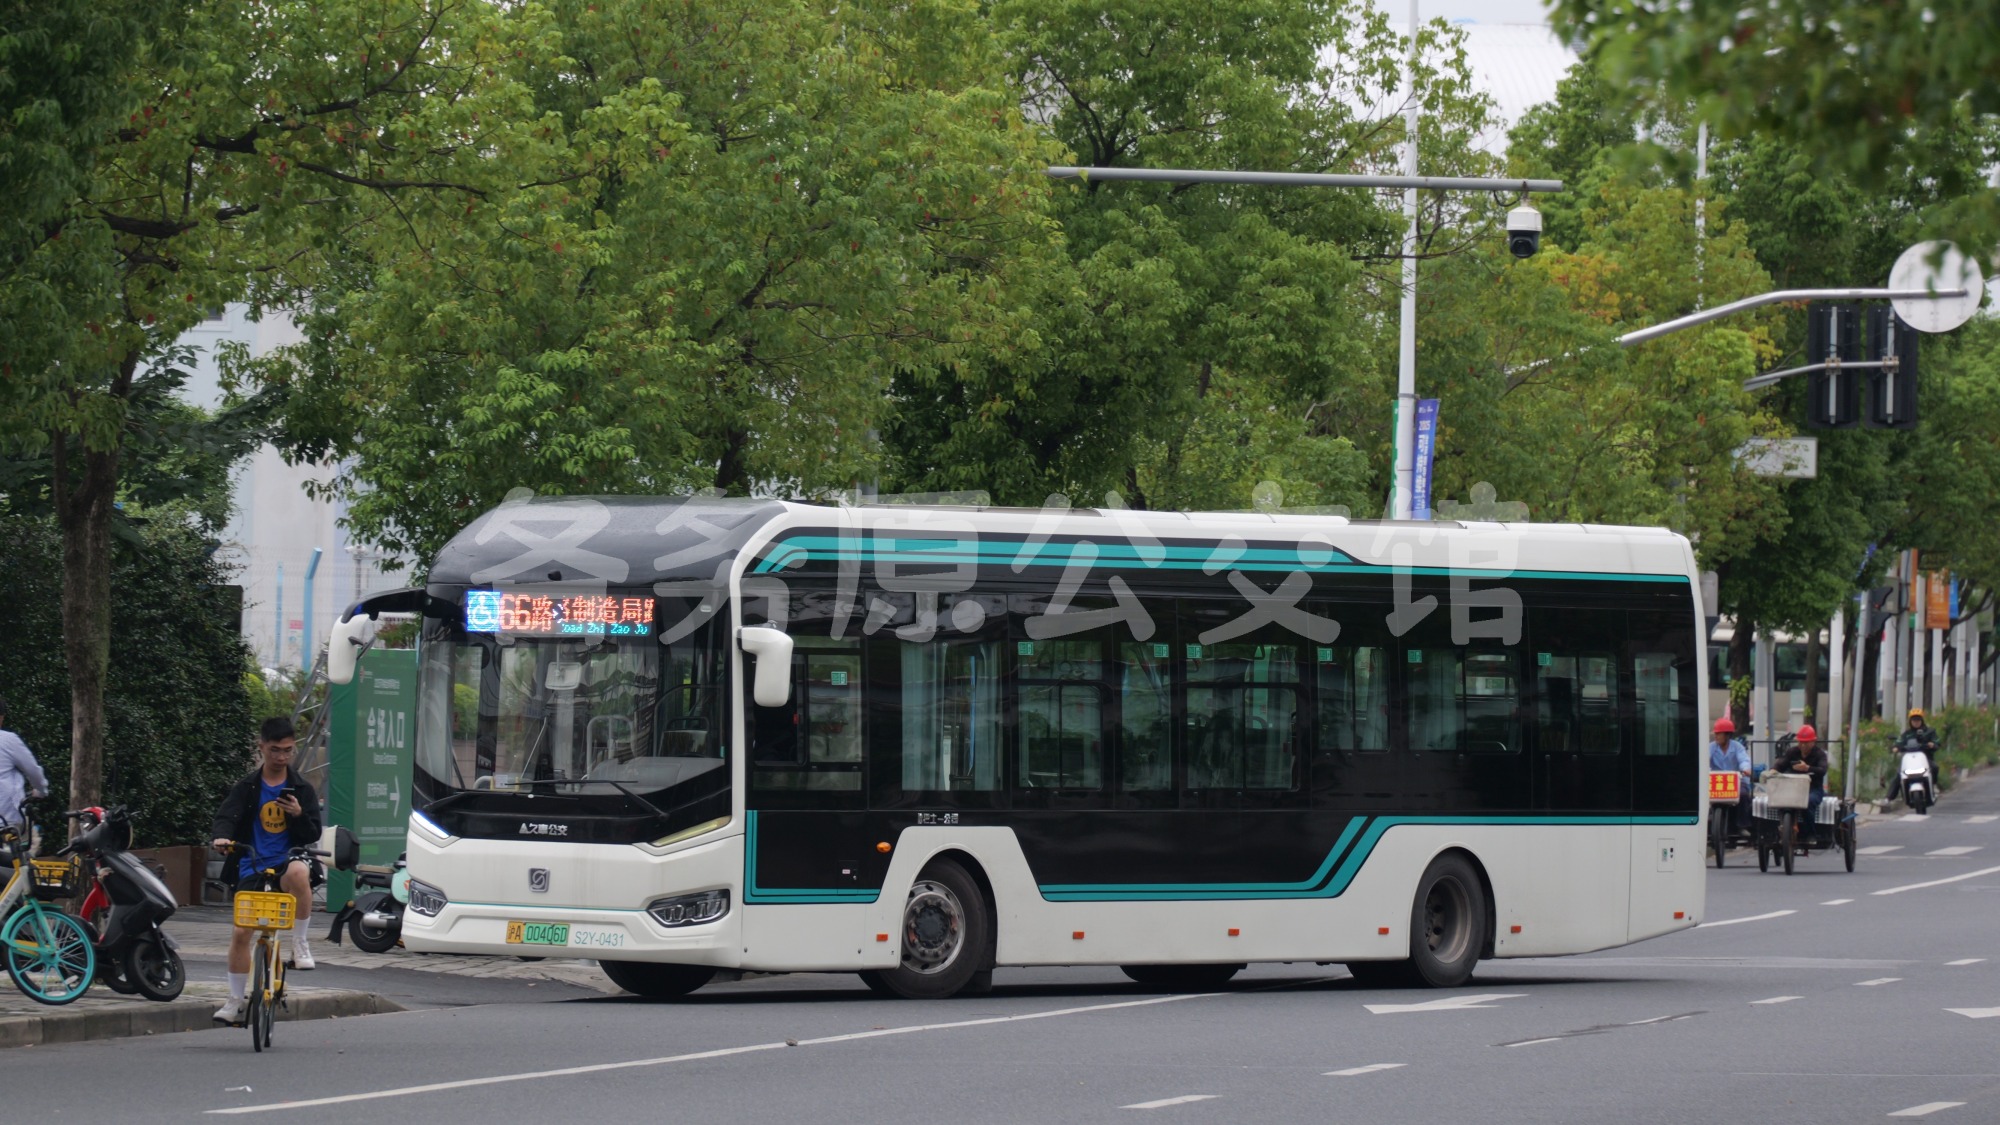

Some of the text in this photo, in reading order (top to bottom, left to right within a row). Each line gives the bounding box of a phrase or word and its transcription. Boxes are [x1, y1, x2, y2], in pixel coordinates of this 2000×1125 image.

[500, 594, 553, 631] 66路
[587, 622, 605, 634] Zhi
[610, 623, 630, 634] Zao
[634, 623, 648, 635] Ju
[366, 706, 405, 749] 会场入口
[574, 930, 625, 947] S2Y-0431
